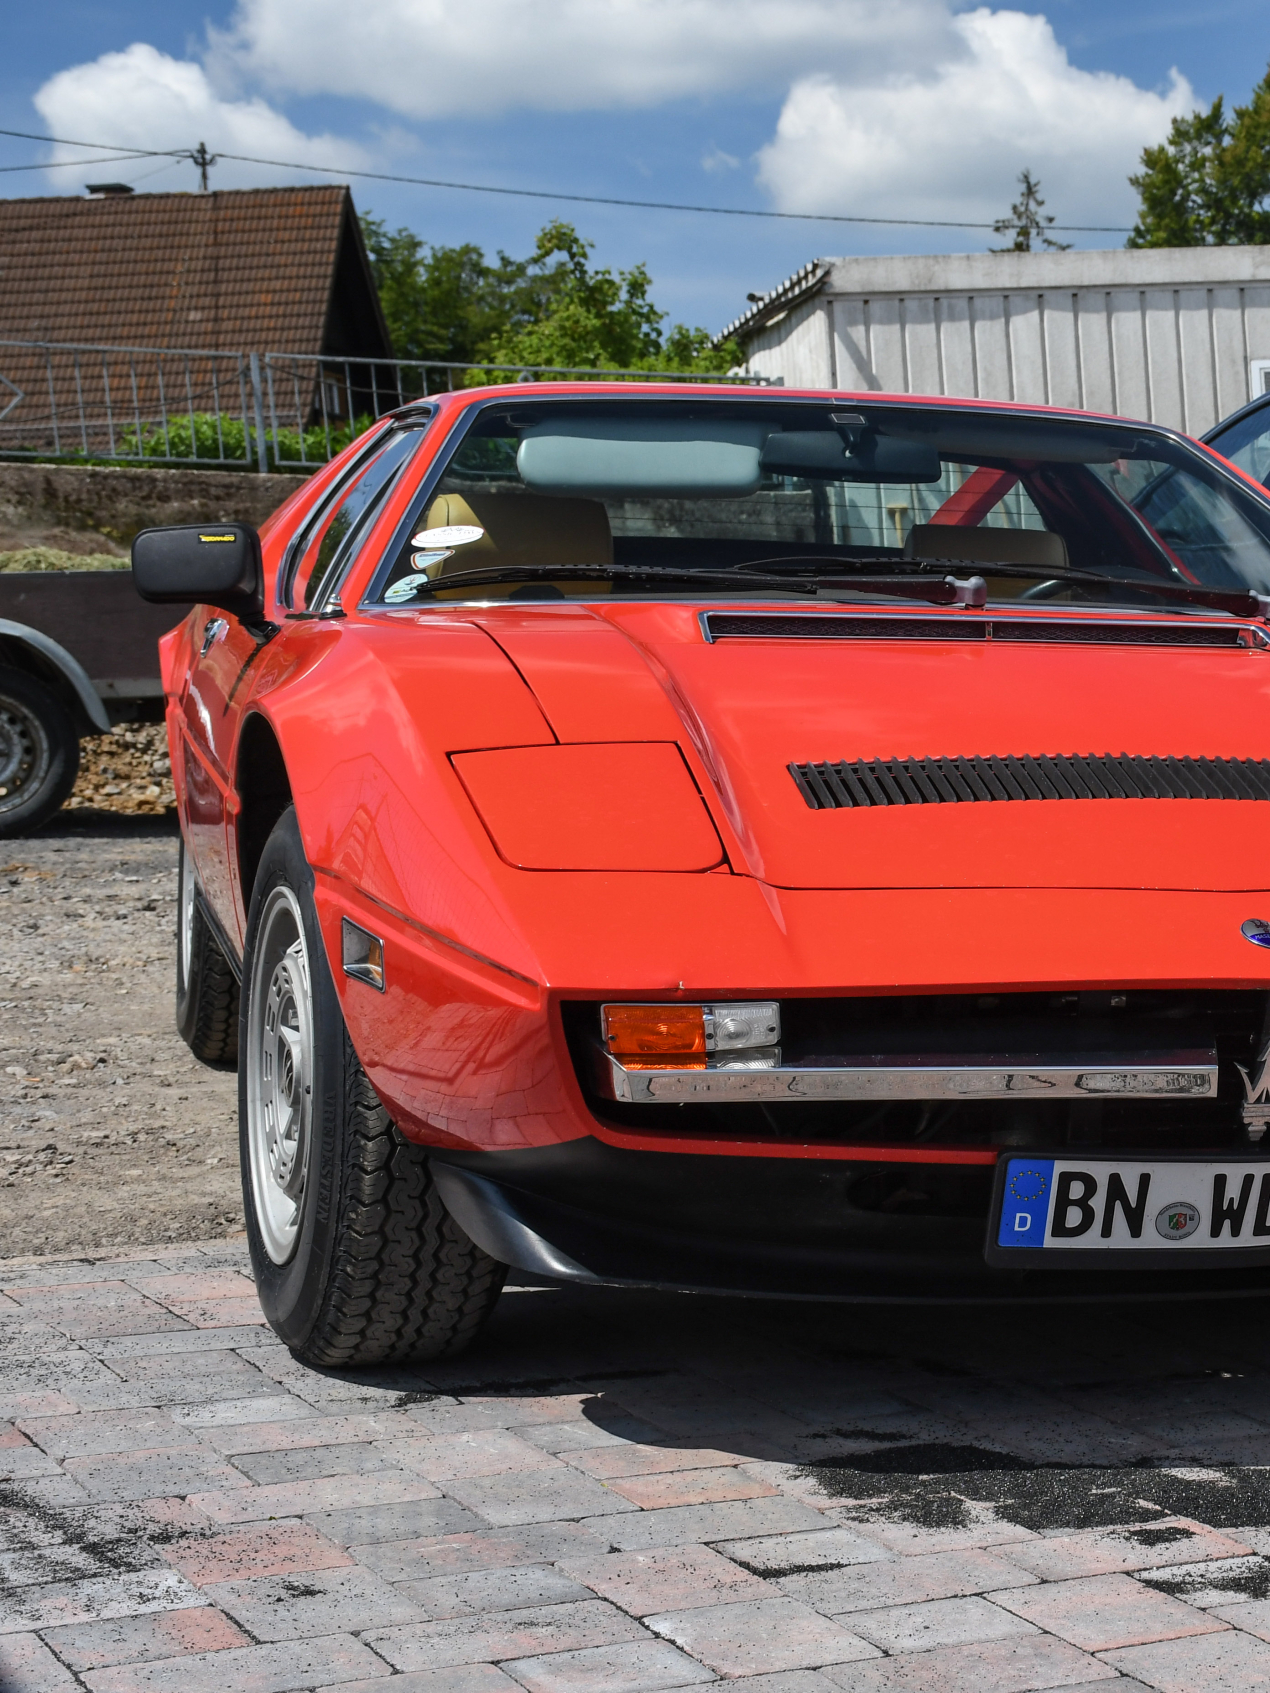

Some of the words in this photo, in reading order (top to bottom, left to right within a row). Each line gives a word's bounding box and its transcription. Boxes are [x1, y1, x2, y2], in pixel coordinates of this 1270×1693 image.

[316, 1091, 337, 1226] VREDESTEIN
[1013, 1212, 1032, 1232] D
[1050, 1171, 1152, 1239] BN
